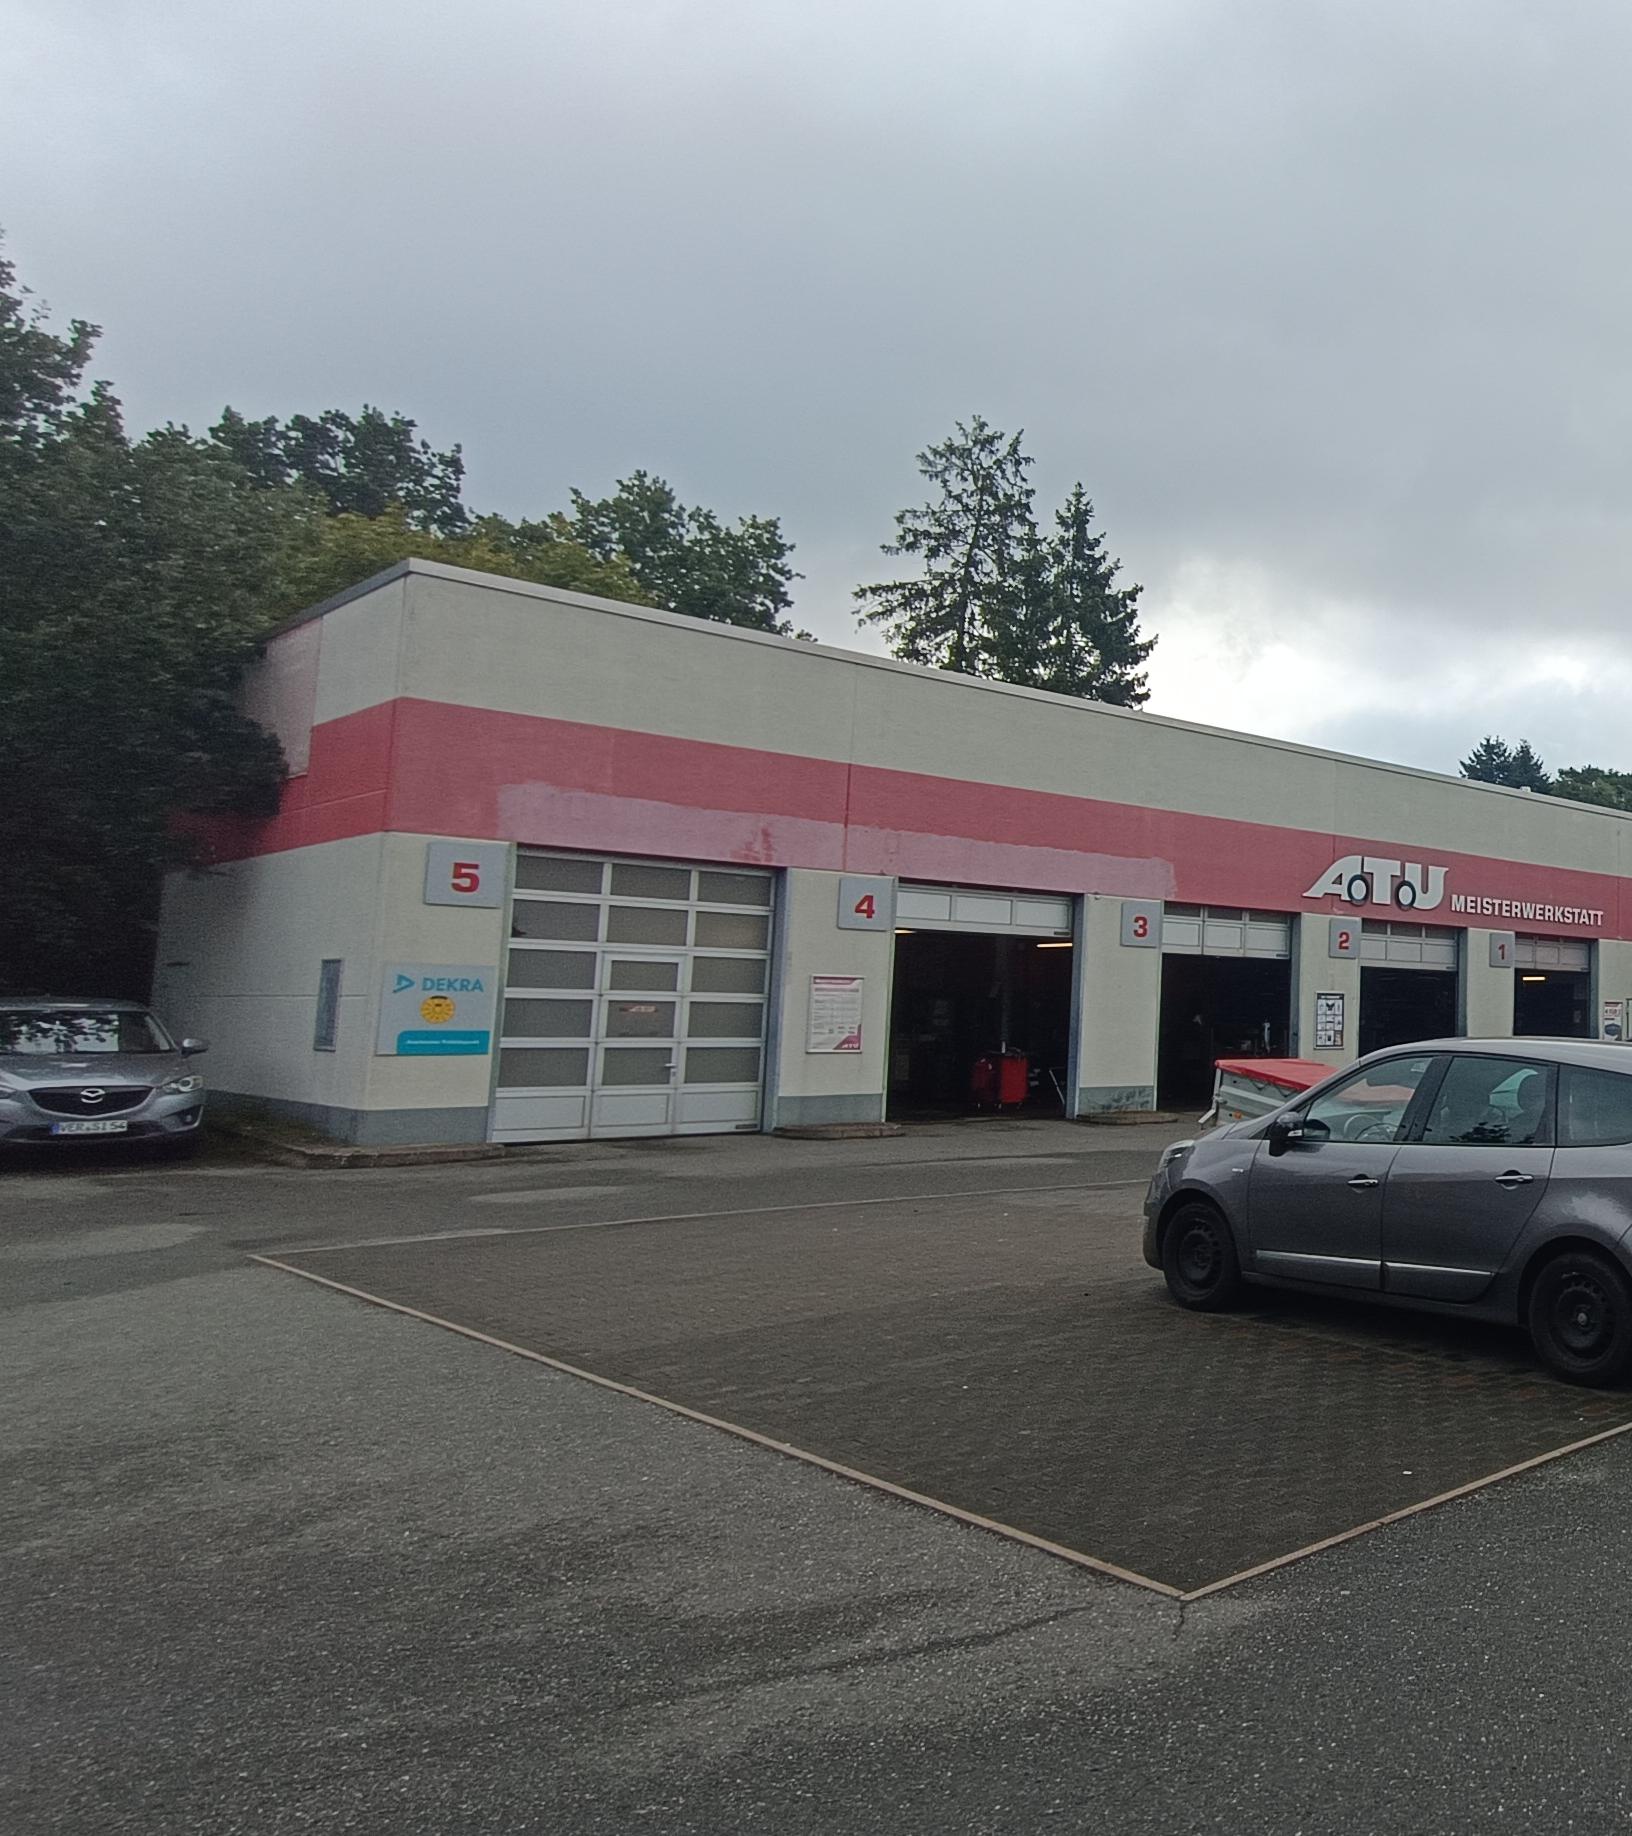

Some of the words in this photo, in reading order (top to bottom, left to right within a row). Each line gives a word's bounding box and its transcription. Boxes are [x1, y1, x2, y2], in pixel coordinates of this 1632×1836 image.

[451, 862, 480, 893] 5
[854, 894, 876, 919] 4
[1451, 894, 1604, 926] MEISTERWERKSTATT
[1133, 916, 1148, 938] 3
[1338, 931, 1350, 950] 2
[1498, 943, 1506, 960] 1
[422, 977, 484, 993] DEKRA
